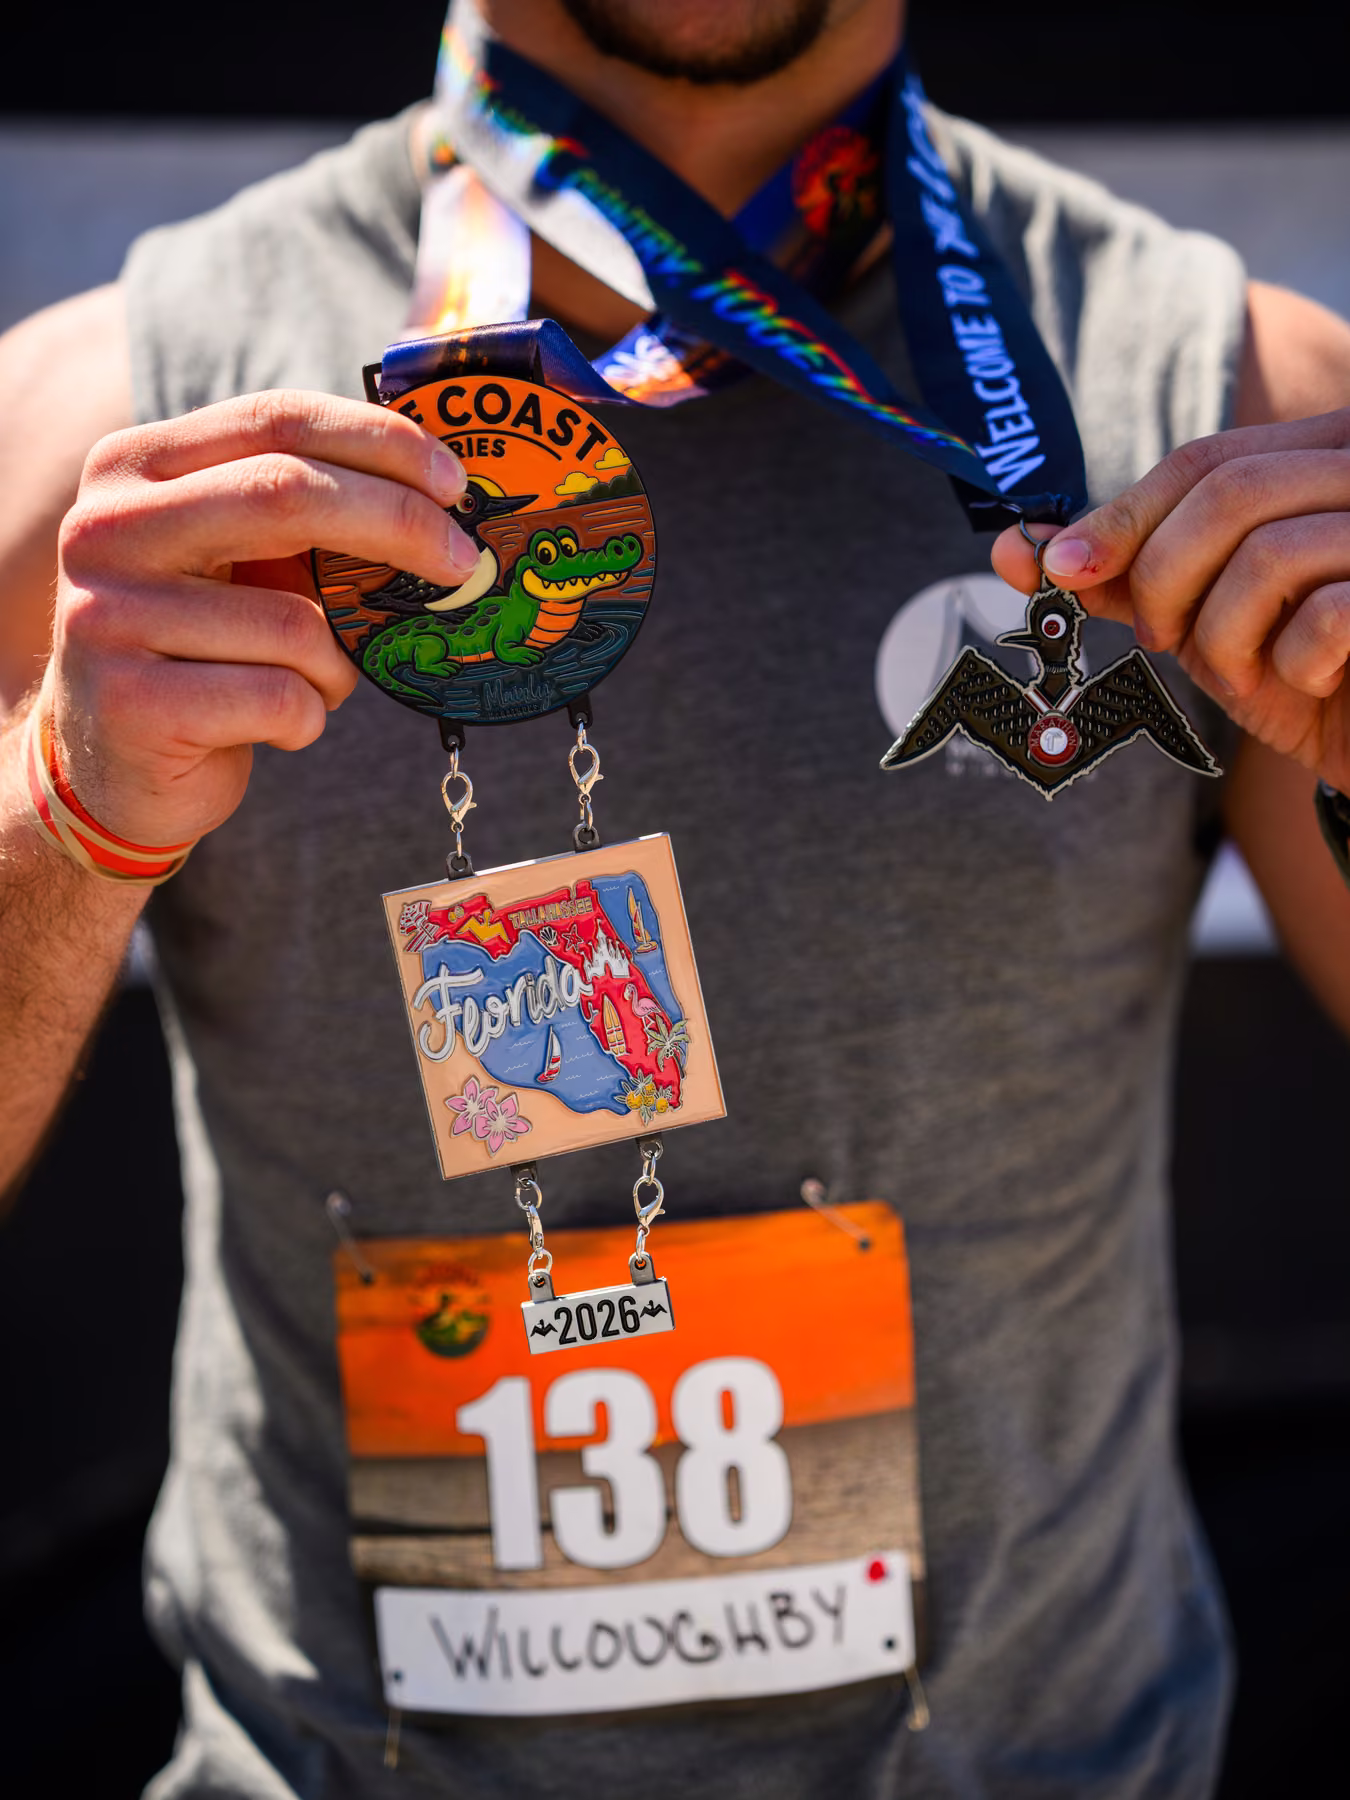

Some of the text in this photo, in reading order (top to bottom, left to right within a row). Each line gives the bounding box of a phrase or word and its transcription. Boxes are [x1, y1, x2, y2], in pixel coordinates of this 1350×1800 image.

[937, 262, 991, 307] TO
[437, 383, 608, 461] COAST
[951, 313, 1046, 493] WELCOME
[1031, 718, 1077, 747] MARATHON
[508, 896, 594, 930] TALLAHASSEE
[413, 954, 594, 1064] Florida
[554, 1295, 641, 1345] 2026
[456, 1356, 793, 1570] 138
[429, 1584, 848, 1683] WILLOUGHBY
